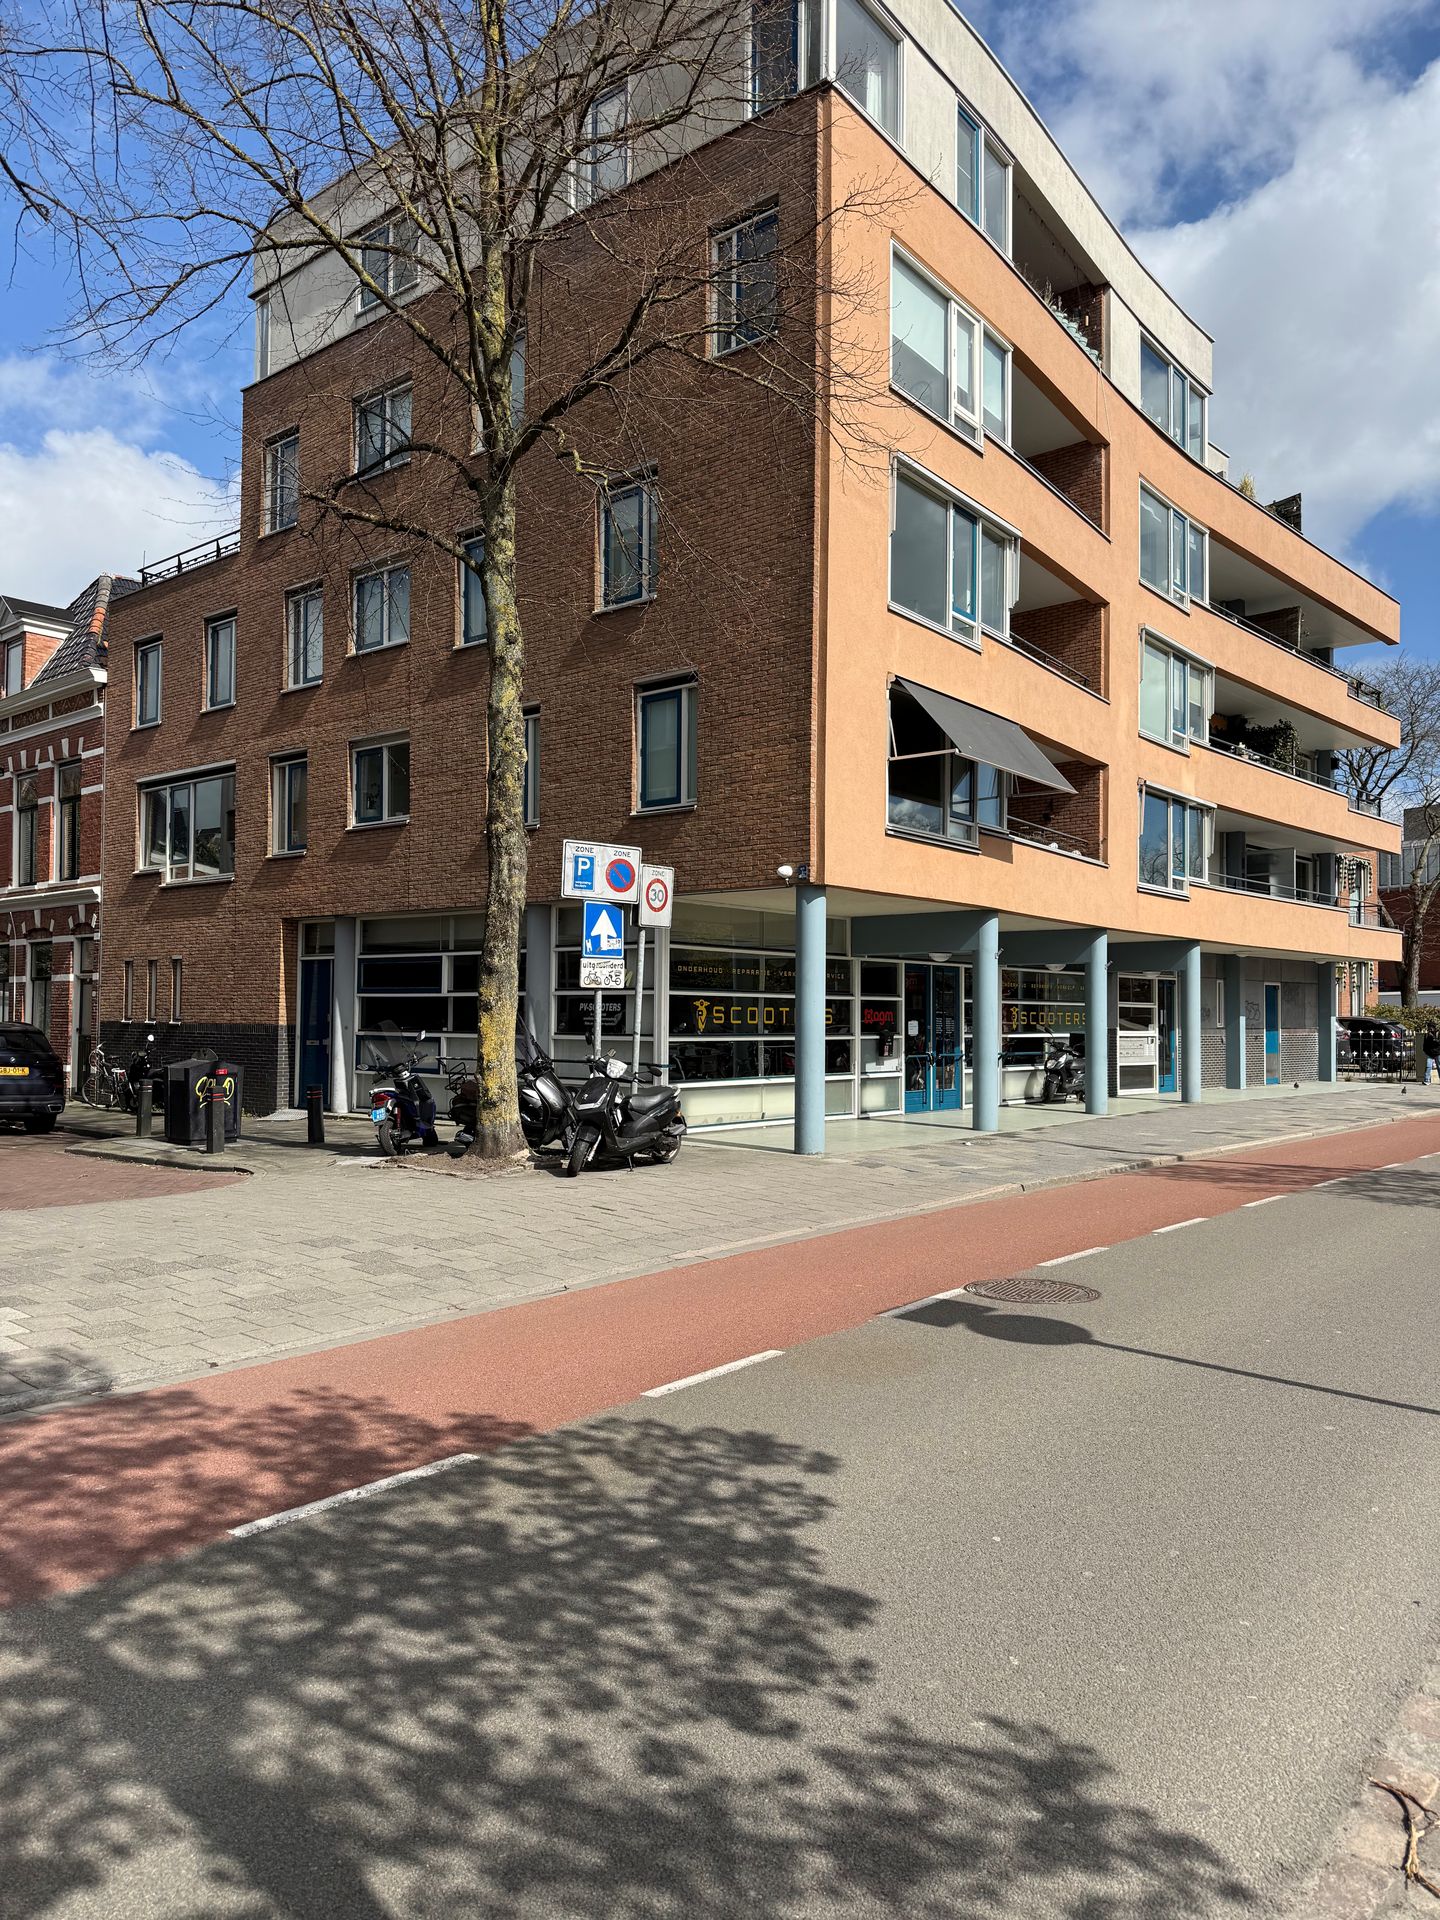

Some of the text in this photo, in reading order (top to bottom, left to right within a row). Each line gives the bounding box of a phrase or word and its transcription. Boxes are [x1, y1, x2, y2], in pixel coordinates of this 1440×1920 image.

[575, 846, 594, 854] ZONE
[613, 850, 631, 858] ZONE
[577, 857, 591, 876] P
[650, 888, 665, 903] 30
[582, 961, 624, 970] uitgnderd
[677, 965, 723, 974] ONDERHOUD
[579, 1002, 622, 1012] PV-SOTERS
[712, 1006, 833, 1024] SCOOTS
